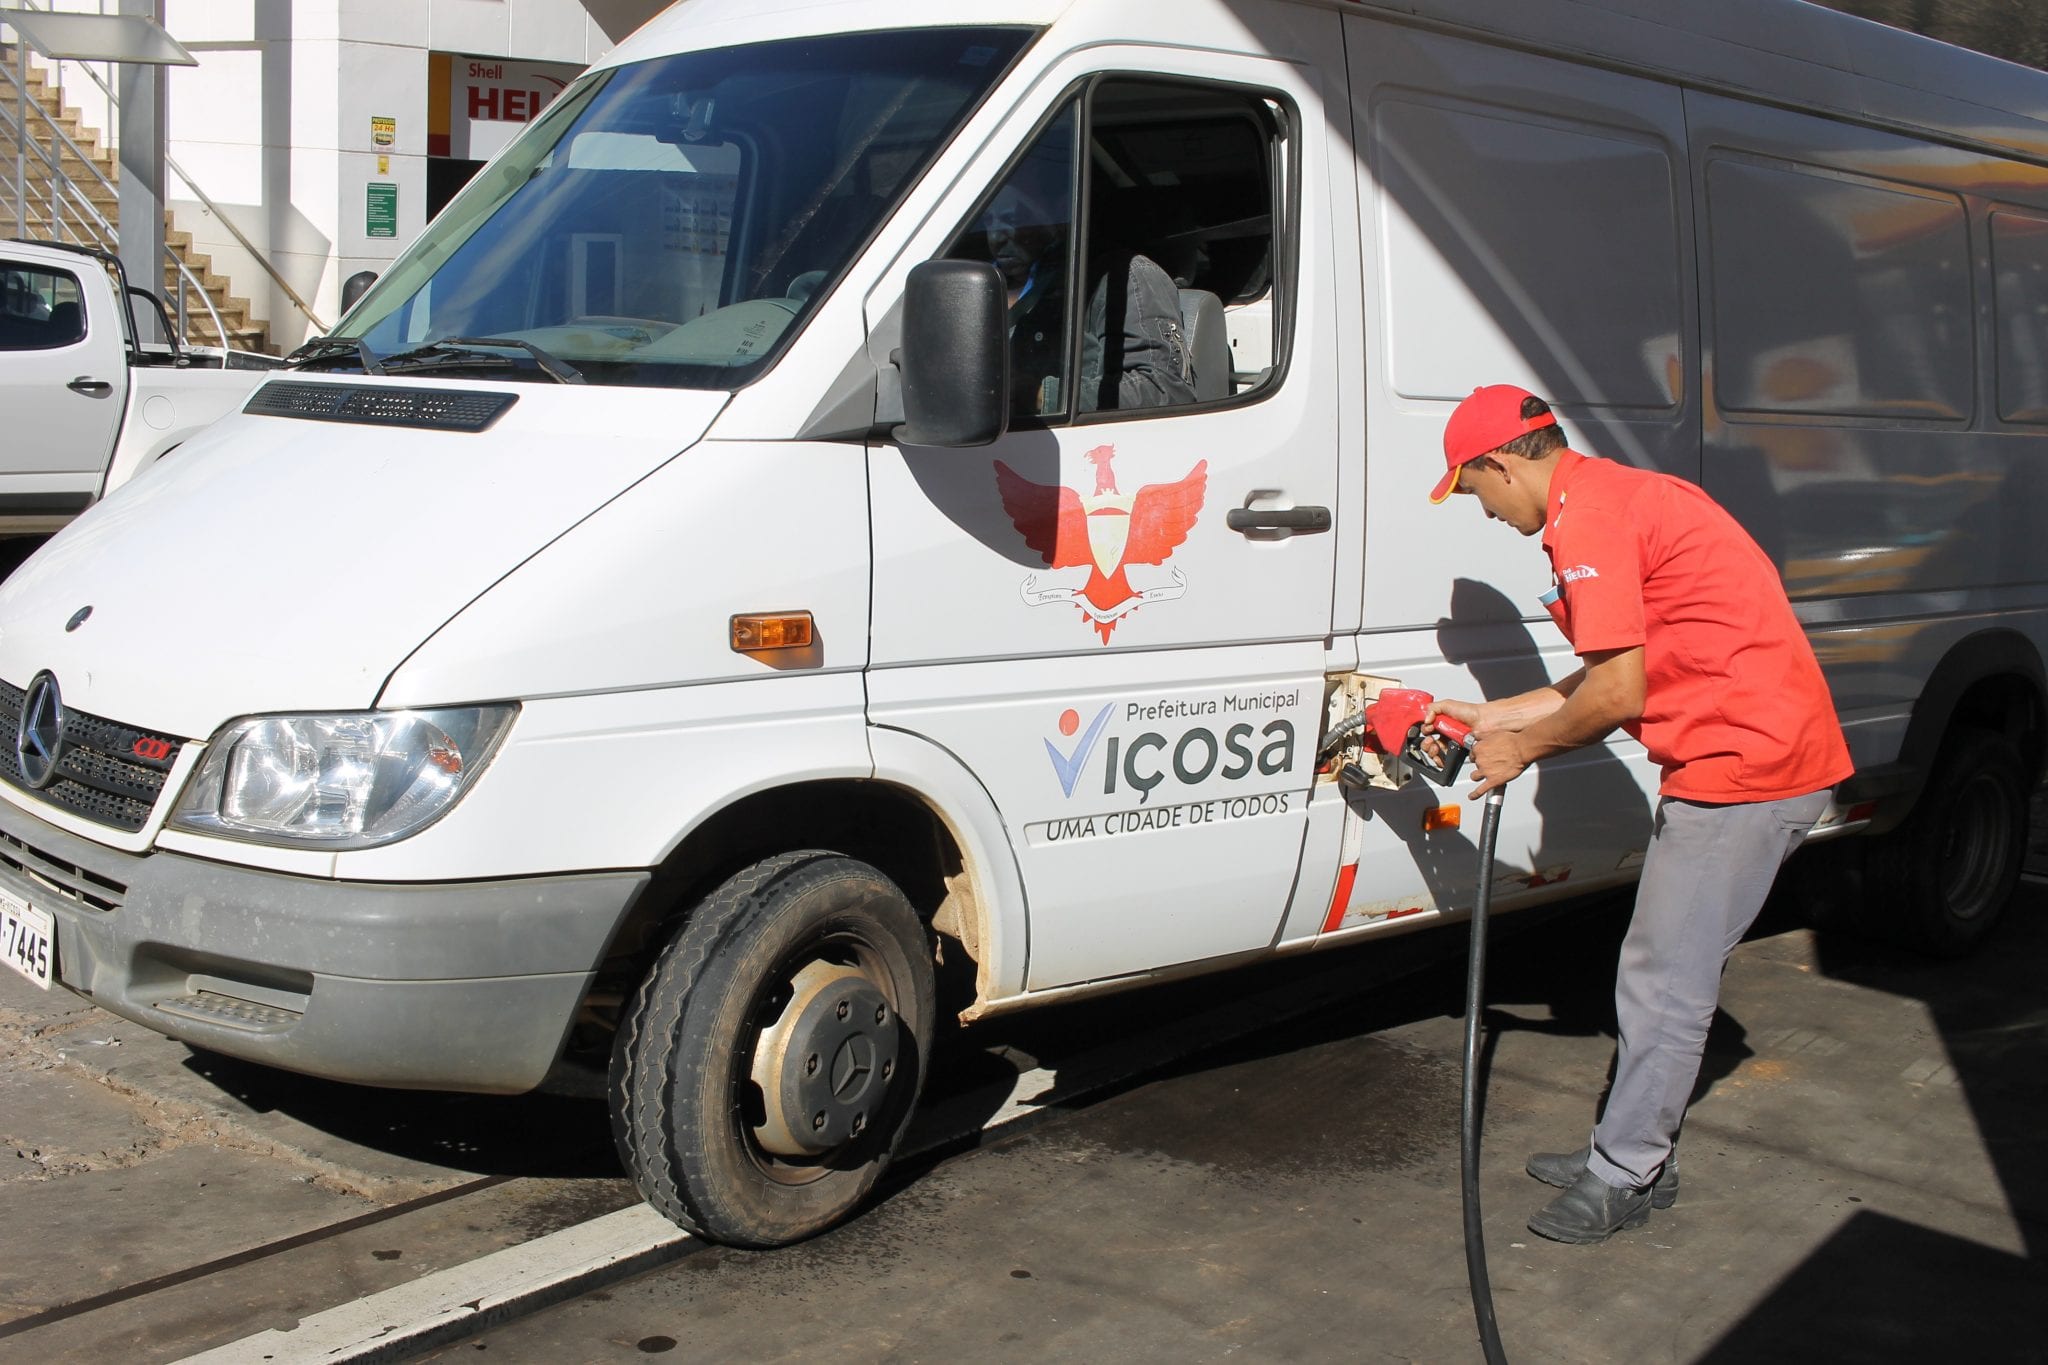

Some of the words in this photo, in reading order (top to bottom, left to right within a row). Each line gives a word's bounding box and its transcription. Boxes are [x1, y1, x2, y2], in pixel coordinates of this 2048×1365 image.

[469, 63, 502, 79] Shell
[1565, 565, 1599, 583] HELIX
[1127, 699, 1216, 721] Prefeitura
[1224, 689, 1299, 713] Municipal
[1046, 818, 1096, 841] UMA
[1105, 807, 1185, 835] CIDADE
[1189, 805, 1213, 825] DE
[1222, 794, 1288, 819] TODOS
